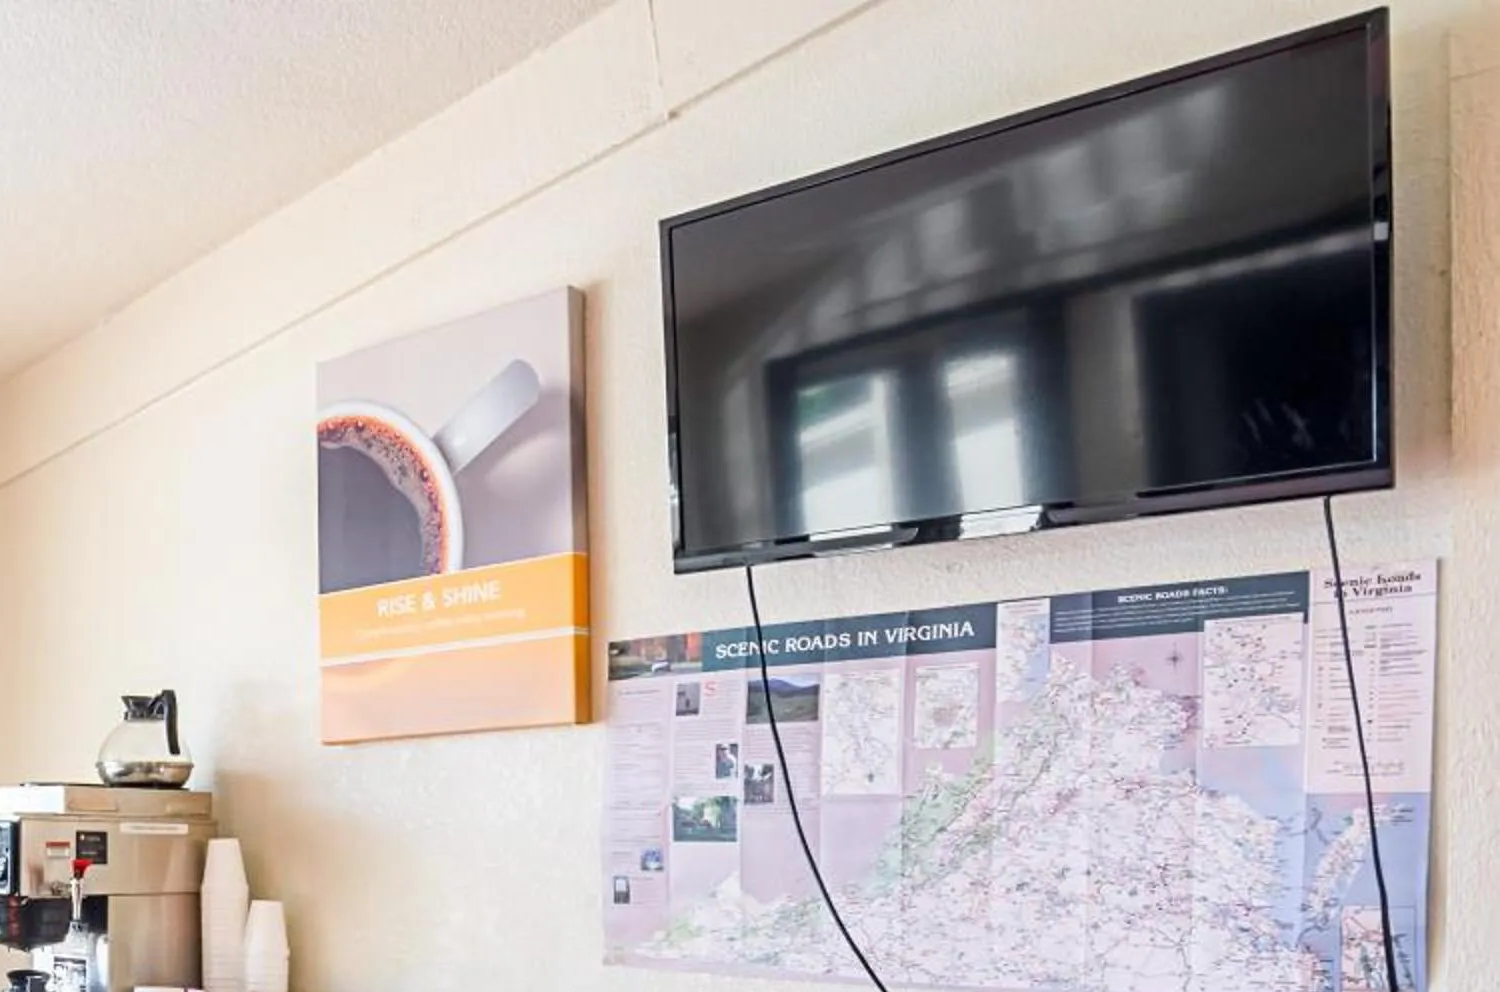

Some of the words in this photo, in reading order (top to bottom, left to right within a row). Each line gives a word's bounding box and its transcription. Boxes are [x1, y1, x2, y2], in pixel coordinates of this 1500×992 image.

[1323, 576, 1373, 589] Senic
[1352, 584, 1413, 597] Virginia
[376, 593, 418, 618] RISE
[421, 591, 436, 612] &
[443, 579, 502, 608] SHINE
[715, 639, 780, 659] SCENIC
[785, 632, 851, 653] ROADS
[857, 630, 878, 647] IN
[884, 620, 975, 644] VIRGINIA
